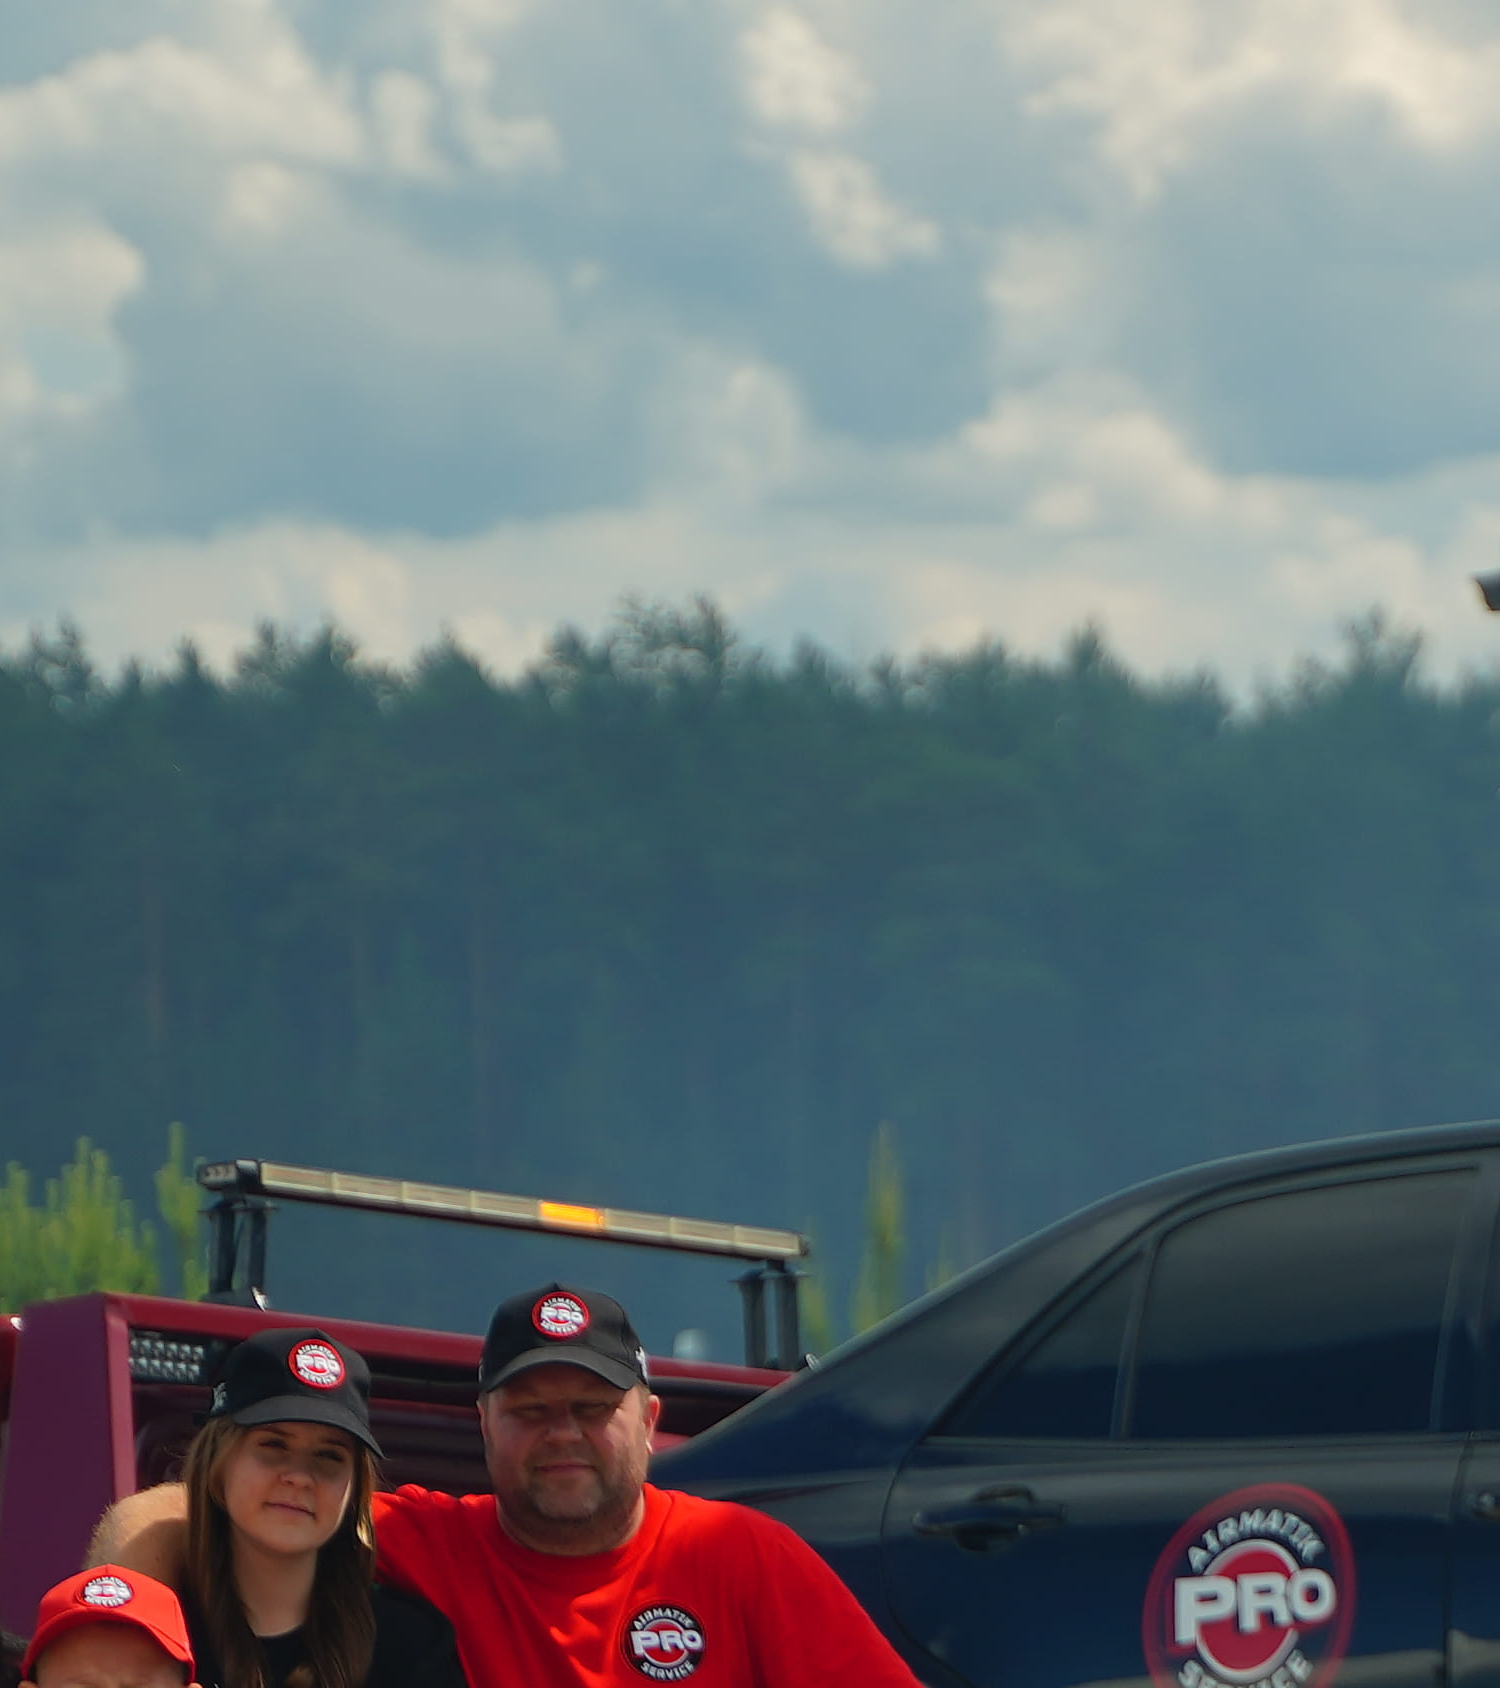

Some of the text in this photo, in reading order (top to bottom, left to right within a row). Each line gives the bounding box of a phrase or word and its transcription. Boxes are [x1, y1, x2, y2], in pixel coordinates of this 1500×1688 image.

[1188, 1508, 1326, 1573] AIRMATIK
[1174, 1568, 1336, 1645] PRO
[630, 1629, 702, 1656] PRO
[640, 1660, 694, 1680] SERVICE
